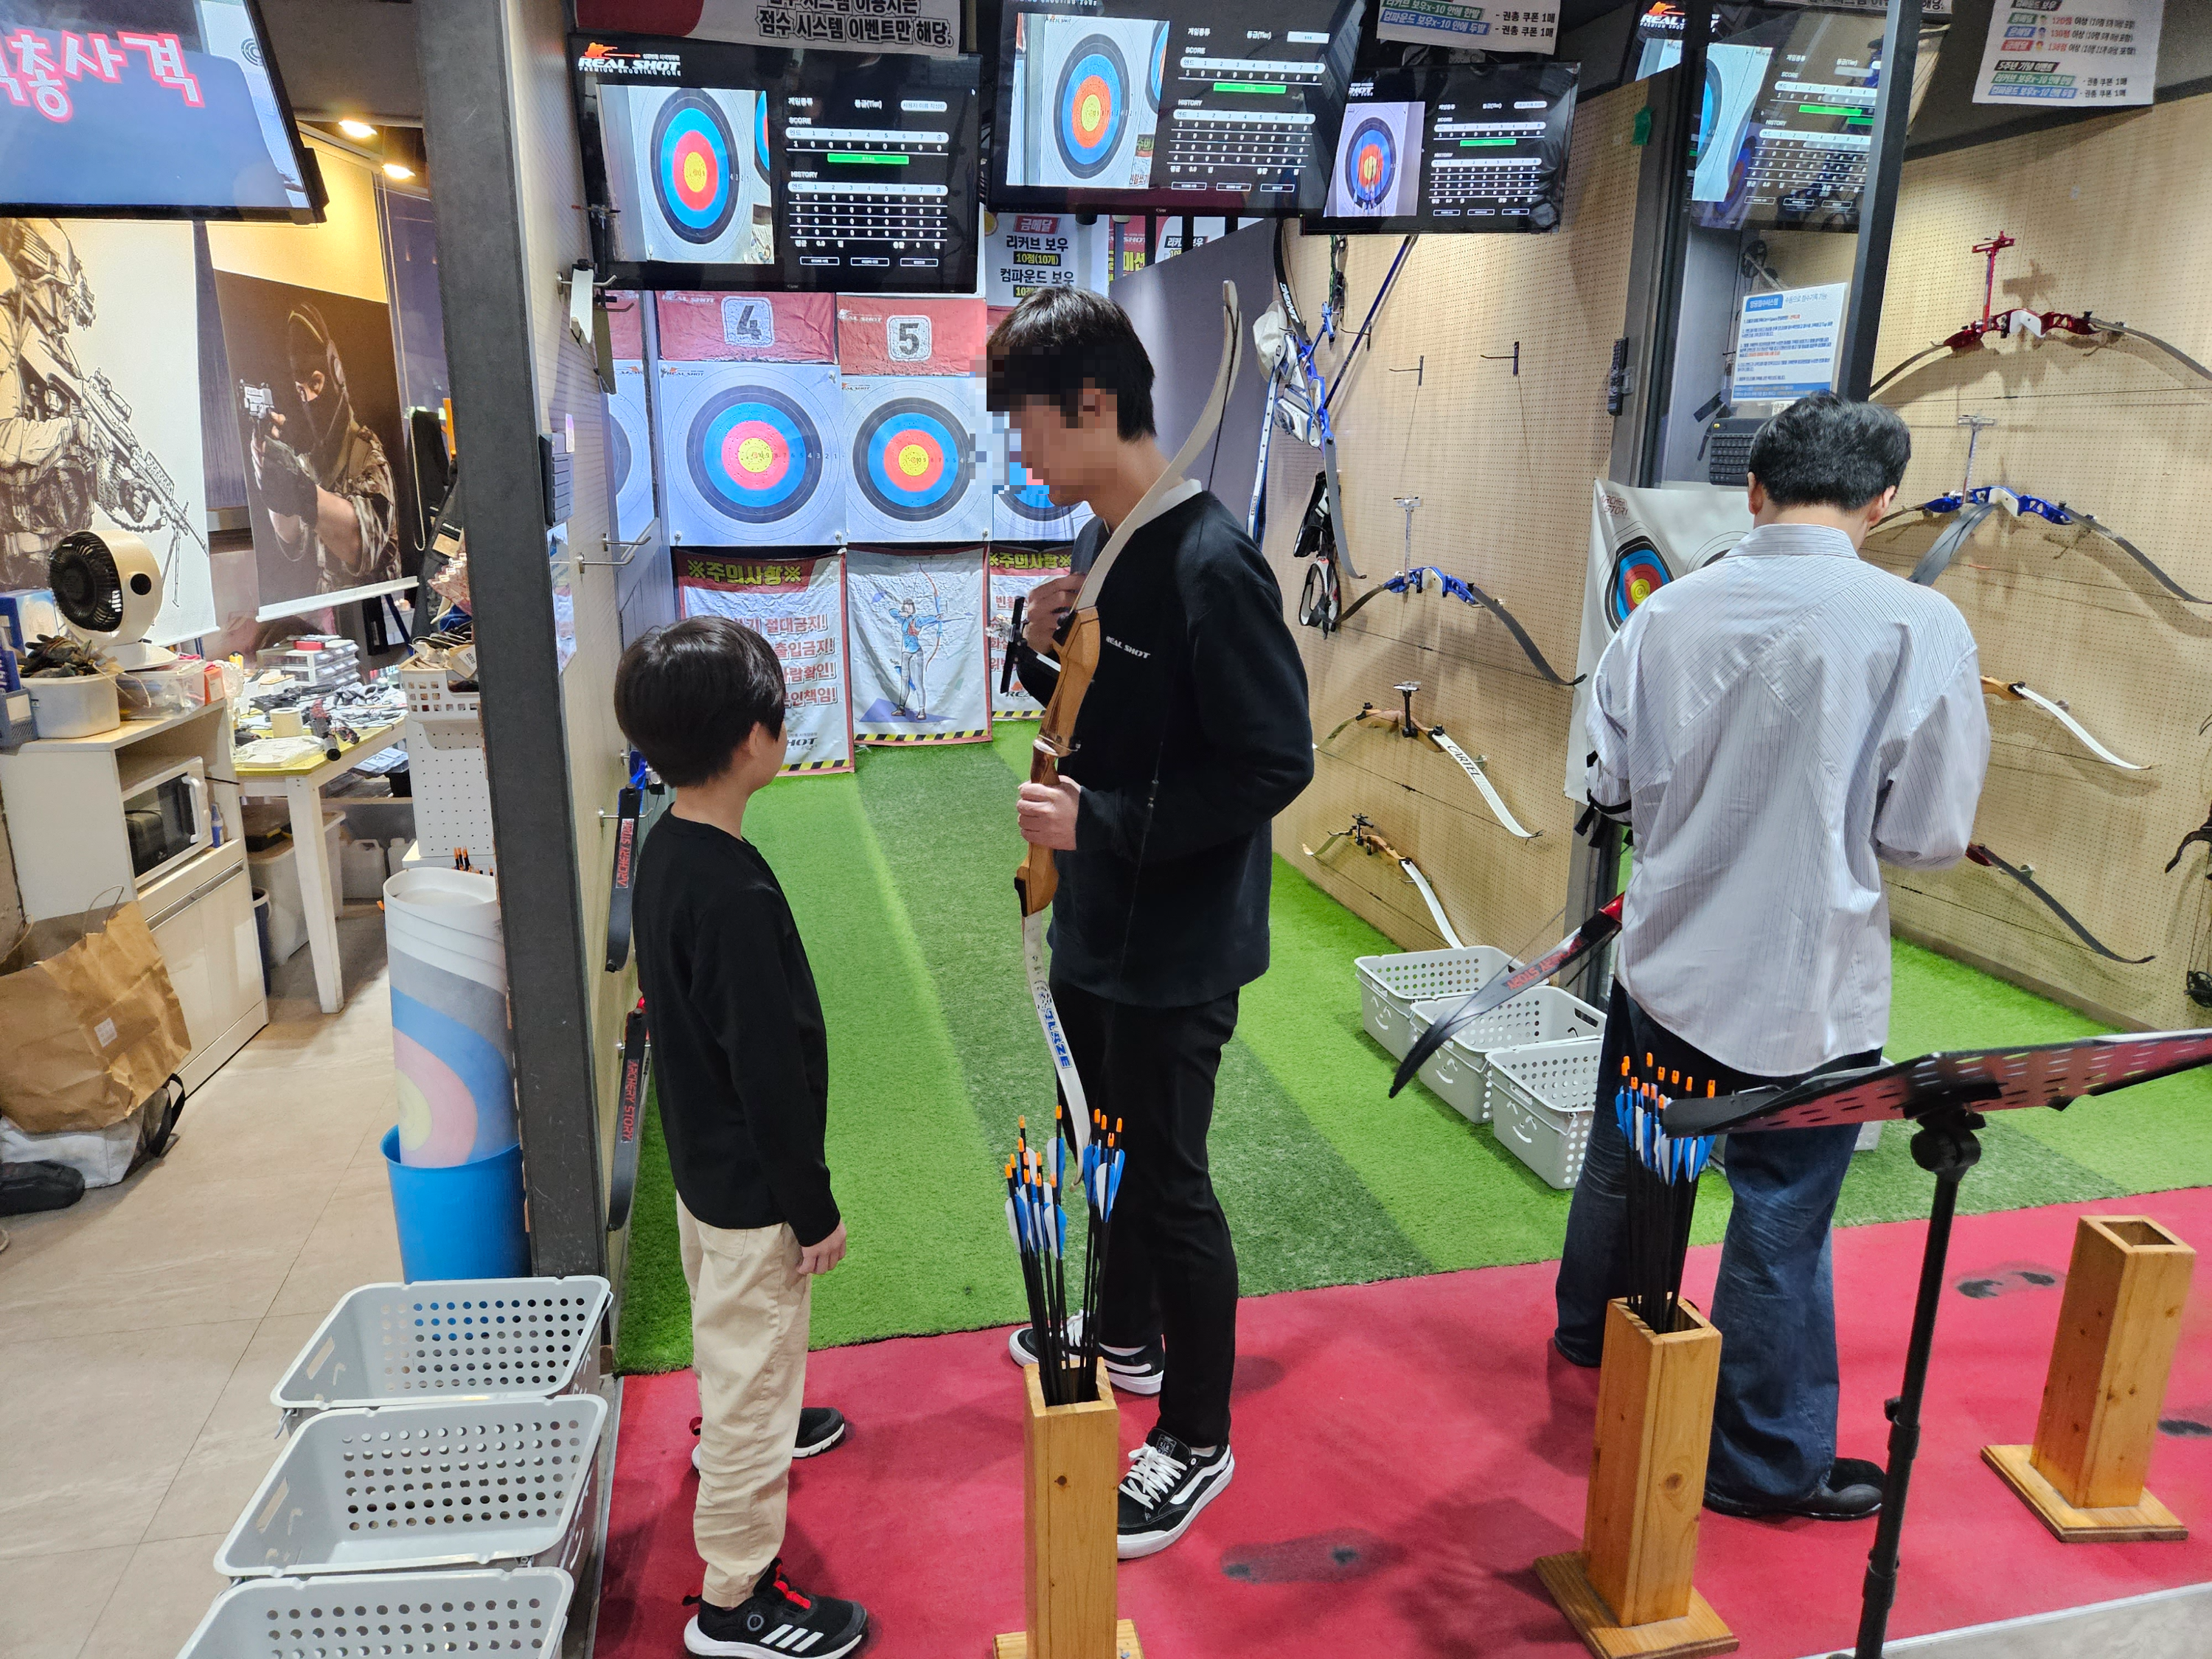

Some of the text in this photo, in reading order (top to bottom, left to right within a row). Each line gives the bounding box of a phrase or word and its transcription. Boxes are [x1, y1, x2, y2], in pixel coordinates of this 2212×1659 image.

[1383, 11, 1416, 24] 컴파운드
[1502, 25, 1519, 36] 권총
[1521, 27, 1538, 37] 쿠폰
[1540, 28, 1554, 38] 1매
[1503, 11, 1519, 21] 권총
[1522, 13, 1539, 22] 쿠폰
[1542, 13, 1555, 23] 1매
[1640, 15, 1678, 25] REAL
[759, 9, 953, 45] 점수 시스템 이벤트만 해당.
[1185, 46, 1206, 55] SCORE
[578, 58, 681, 71] REAL SHOT
[789, 116, 812, 125] SCORE
[790, 170, 818, 178] HISTORY
[1020, 218, 1052, 232] 금메달
[1006, 235, 1068, 252] 리커브 보우
[1016, 253, 1059, 265] 10점(10개)
[1000, 268, 1075, 284] 컴파운드 보우
[661, 294, 715, 304] REAL SHOT
[737, 305, 761, 340] 4
[899, 322, 919, 355] 5
[765, 613, 828, 634] 절대금지!
[774, 637, 835, 658] 출입금지!
[1106, 636, 1151, 658] REAL SHOT
[1447, 745, 1481, 779] CARTEL
[616, 844, 632, 887] ARCHERY
[1506, 967, 1540, 990] STORY
[621, 1060, 639, 1142] ARCHERY STORY
